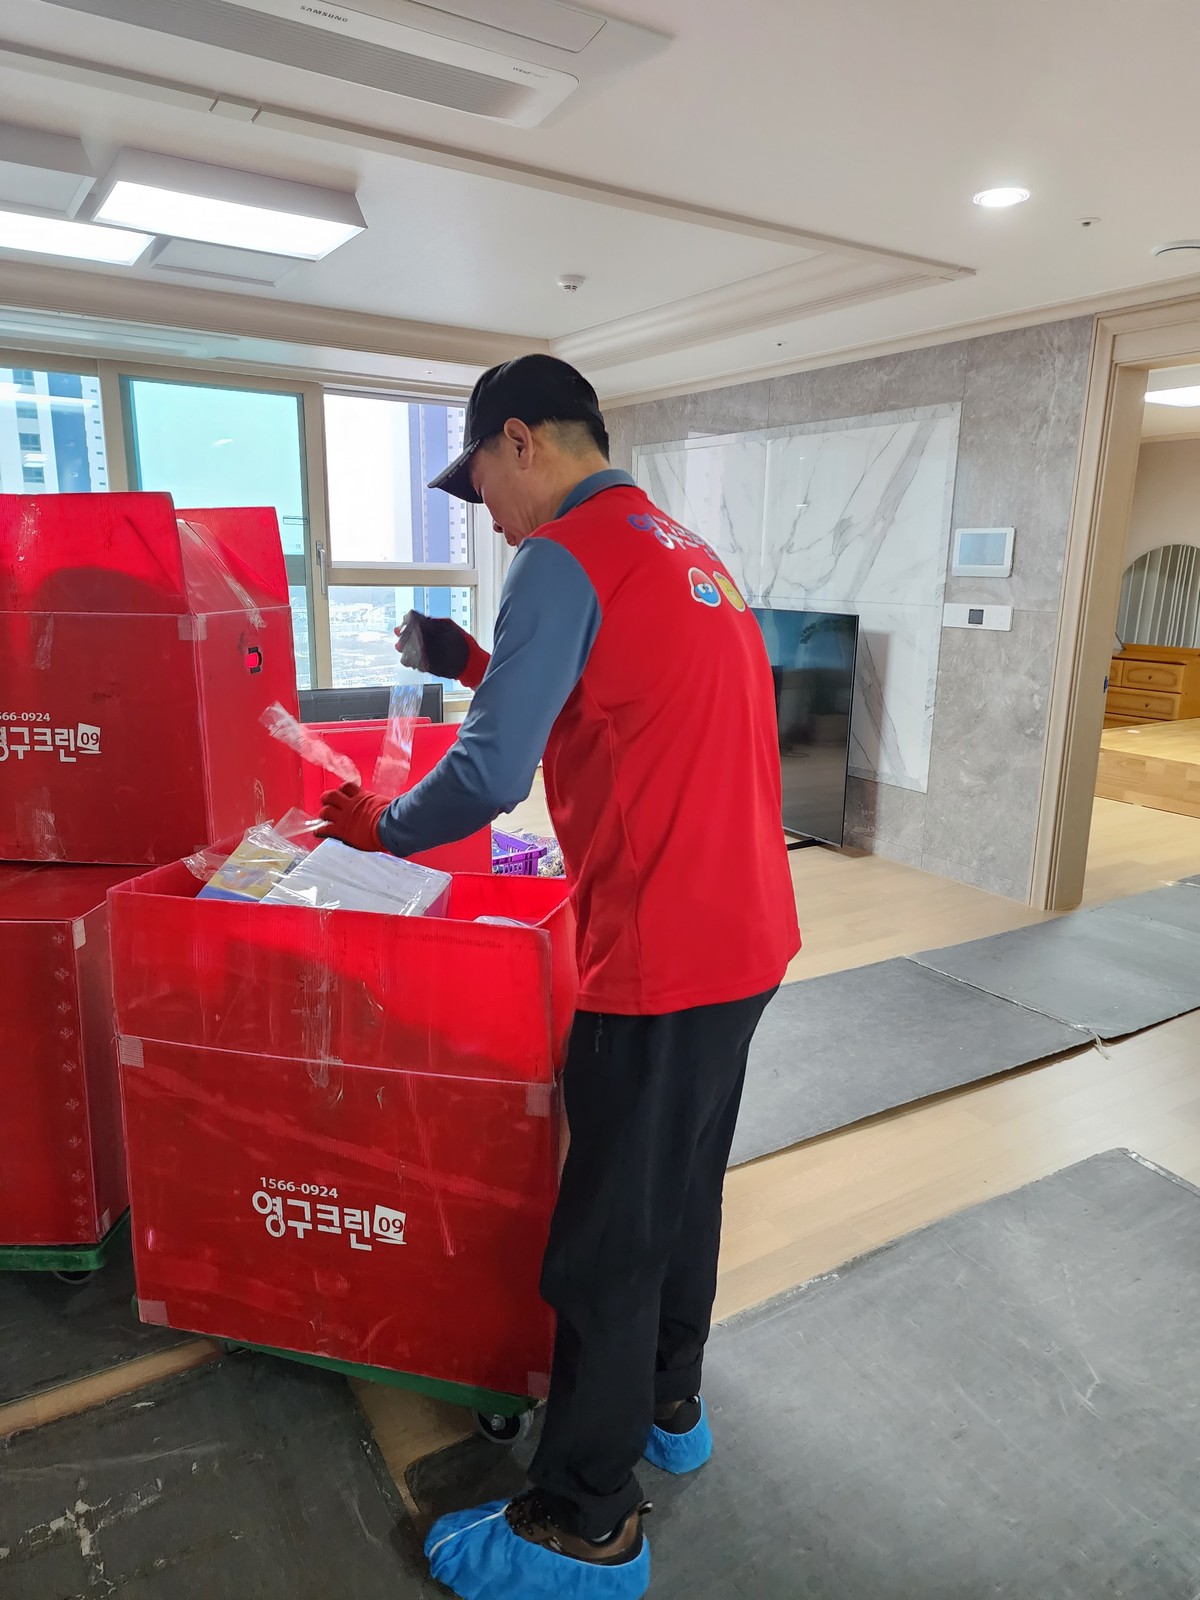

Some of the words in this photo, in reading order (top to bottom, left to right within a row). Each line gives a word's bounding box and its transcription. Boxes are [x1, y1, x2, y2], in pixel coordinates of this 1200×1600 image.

[300, 5, 348, 22] SAMSUNG
[0, 712, 51, 721] 66-0924
[260, 1177, 338, 1198] 1566-0924
[252, 1191, 372, 1251] 영구크린
